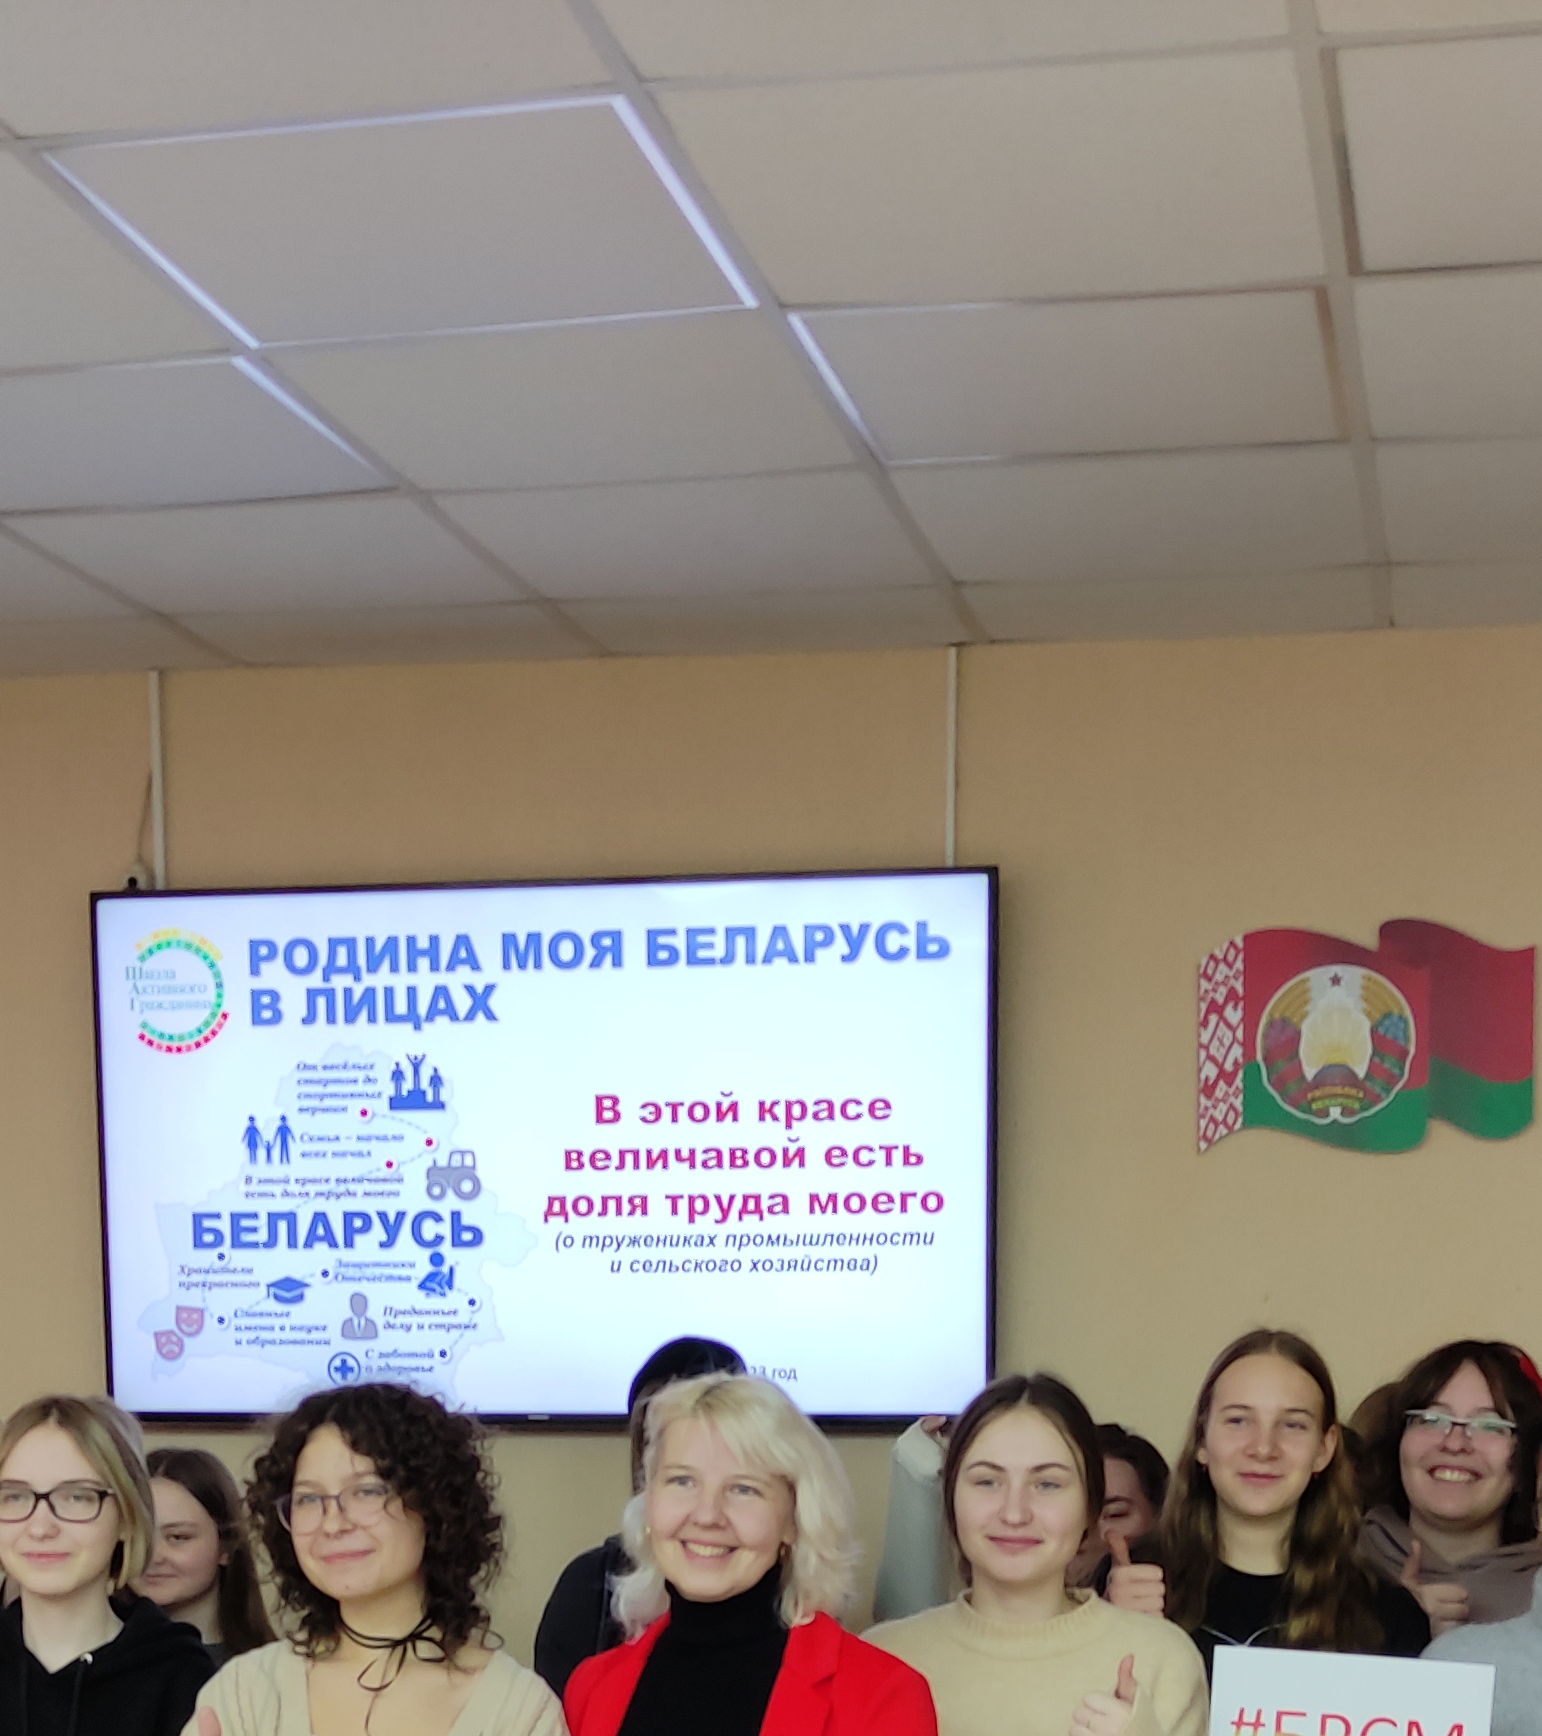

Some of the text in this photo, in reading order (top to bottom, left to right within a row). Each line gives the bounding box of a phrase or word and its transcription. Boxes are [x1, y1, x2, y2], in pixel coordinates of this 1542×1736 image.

[249, 934, 481, 982] РОДИНА
[501, 929, 621, 970] МОЯ
[646, 921, 951, 967] БЕЛАРУСЬ
[250, 984, 498, 1031] В ЛИЦАХ
[595, 1091, 893, 1130] В этой красе
[564, 1136, 924, 1171] величавой есть
[543, 1191, 944, 1224] доля труда моего
[192, 1211, 484, 1249] БЕЛАРУСЬ
[555, 1231, 935, 1252] (о тружениках промышленности
[610, 1253, 878, 1276] и сельского хозяйства)
